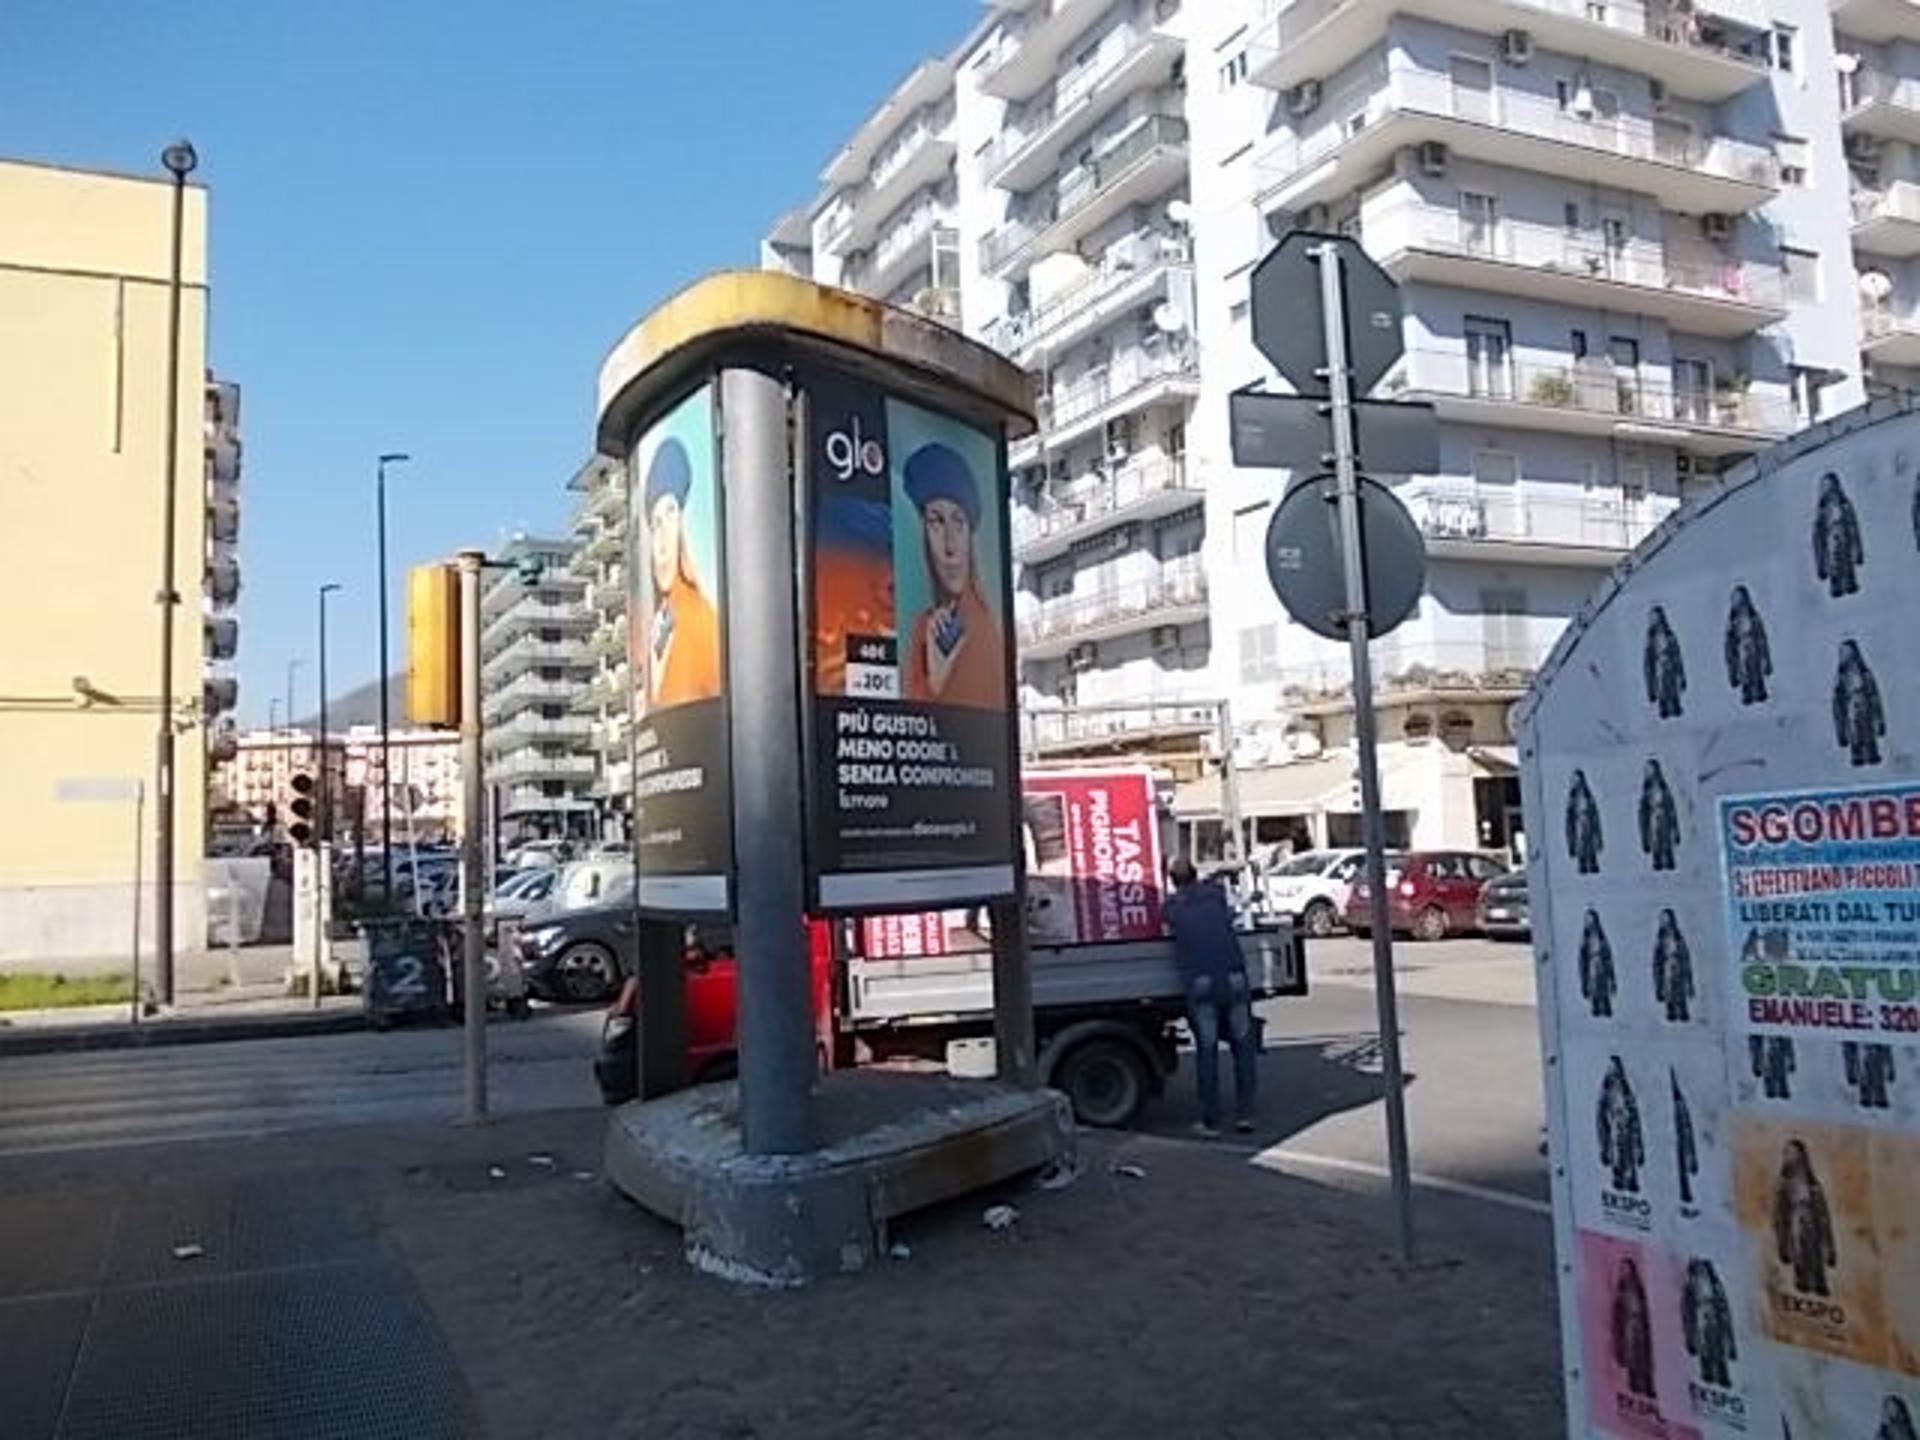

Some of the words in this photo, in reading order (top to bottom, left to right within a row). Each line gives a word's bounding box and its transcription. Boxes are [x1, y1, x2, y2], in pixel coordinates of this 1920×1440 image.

[826, 413, 884, 480] glo
[837, 708, 869, 733] PIÙ
[872, 713, 928, 736] GUSTO
[837, 738, 894, 760] MENO
[838, 764, 897, 785] SENZA
[1112, 820, 1147, 926] TASSE
[1846, 863, 1912, 889] PICCOLI
[1741, 903, 1830, 922] LIBERATI
[1838, 903, 1878, 922] DAL
[1884, 902, 1920, 922] TU
[390, 956, 426, 993] 2
[1742, 965, 1920, 1002] GRATU
[1750, 999, 1873, 1029] EMANUELE:
